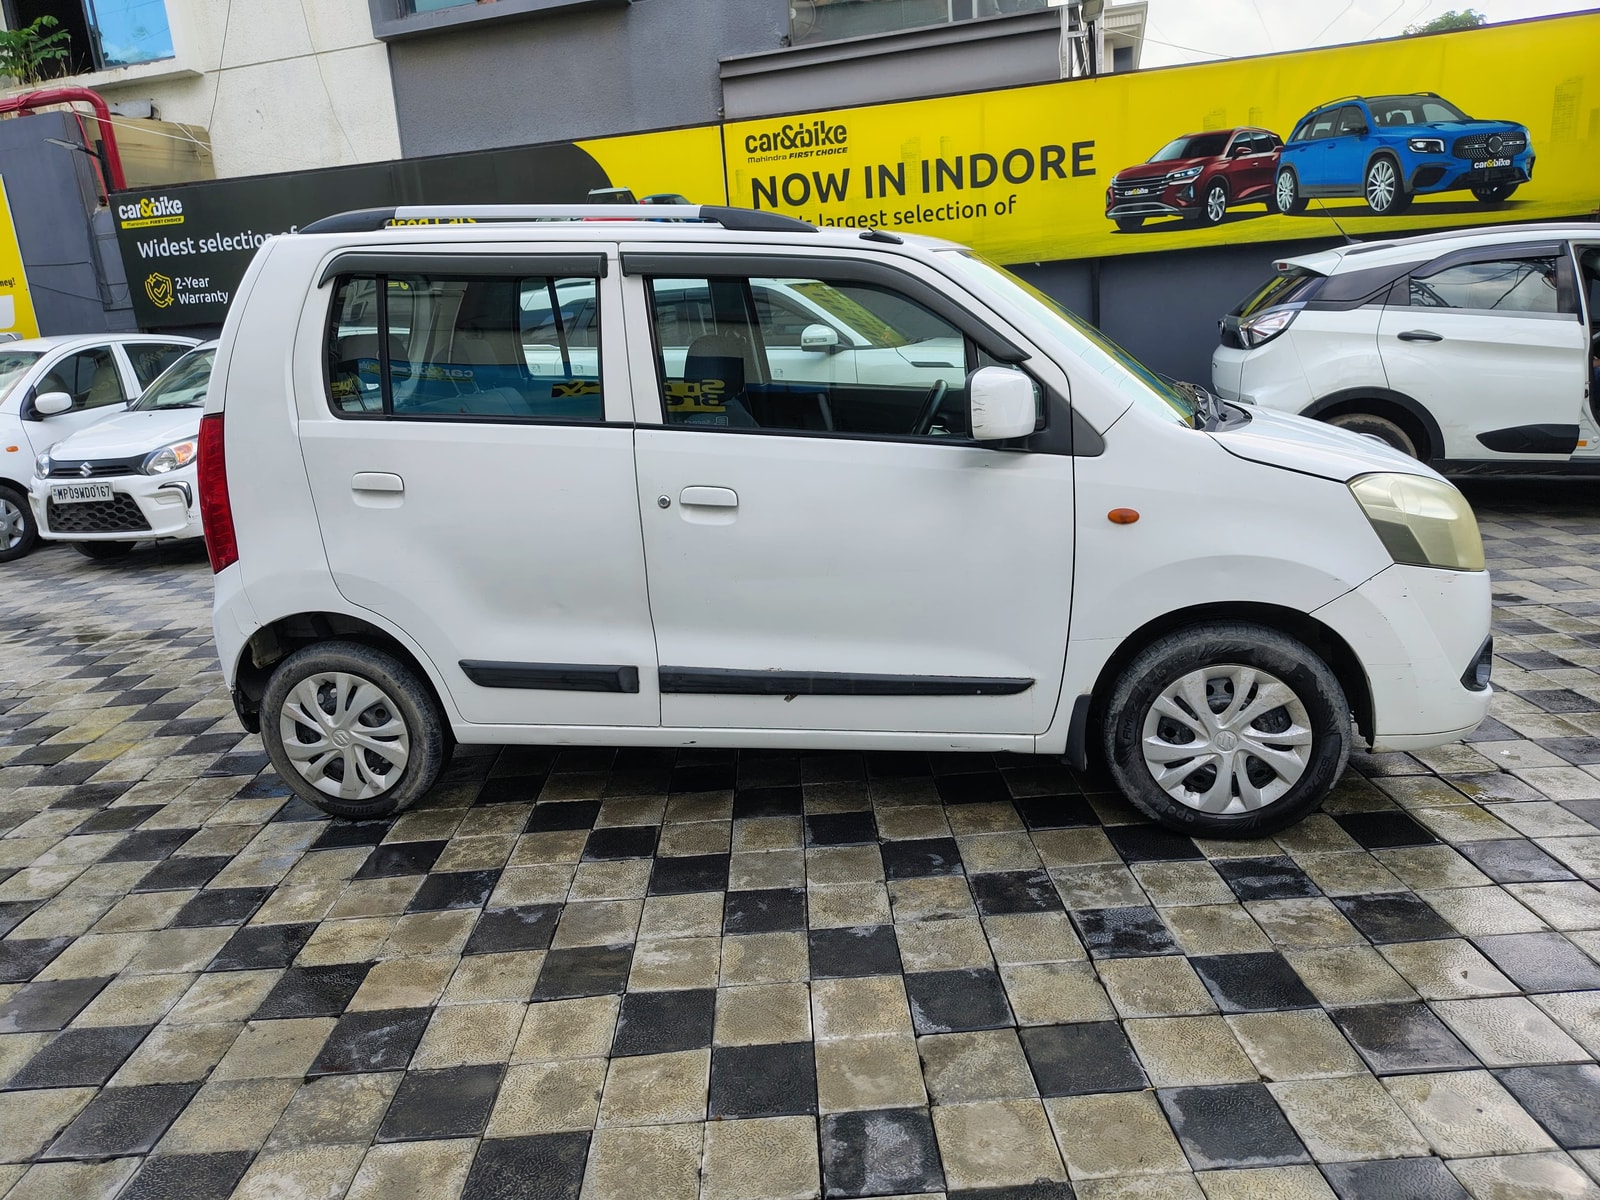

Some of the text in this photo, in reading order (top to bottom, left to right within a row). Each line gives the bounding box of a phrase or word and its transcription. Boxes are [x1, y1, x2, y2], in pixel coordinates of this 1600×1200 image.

[745, 120, 847, 154] car&bike
[747, 147, 848, 164] Mahindra FIRST CHOICE
[751, 140, 1097, 209] NOW IN INDORE
[118, 196, 183, 220] car&bike
[819, 194, 1017, 228] largest selection of
[137, 236, 196, 259] Widest
[175, 277, 210, 289] 2-Year
[177, 290, 229, 304] Warranty
[56, 485, 111, 501] MP09WD0167
